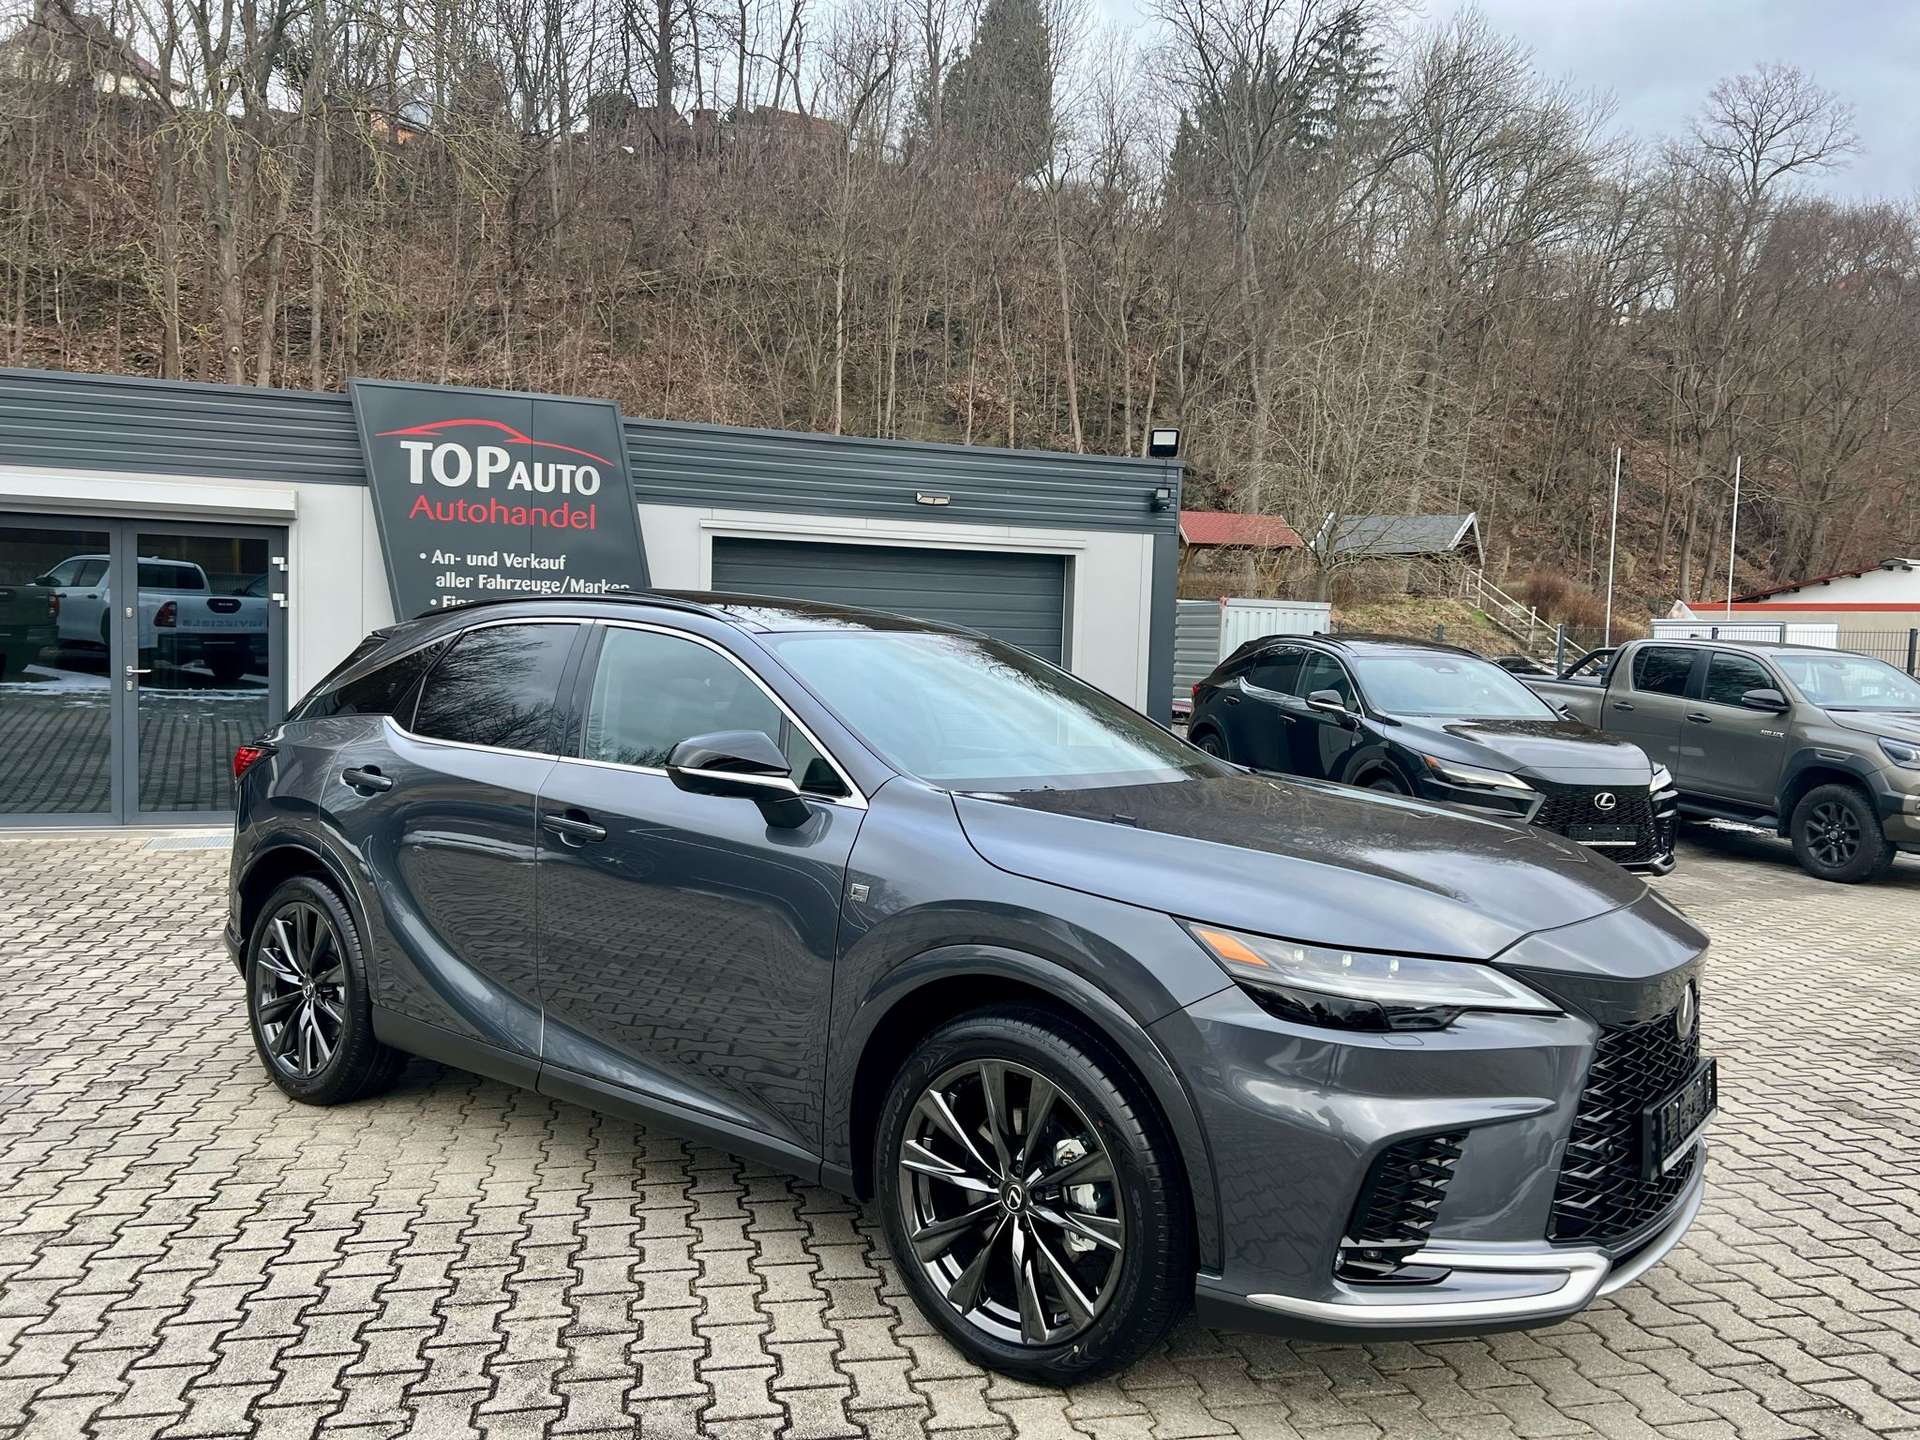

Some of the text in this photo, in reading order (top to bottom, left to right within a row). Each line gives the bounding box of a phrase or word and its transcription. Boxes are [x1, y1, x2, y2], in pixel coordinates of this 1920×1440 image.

[409, 495, 597, 530] Autohandel
[431, 550, 567, 570] An- und Verkauf
[435, 572, 474, 588] aller
